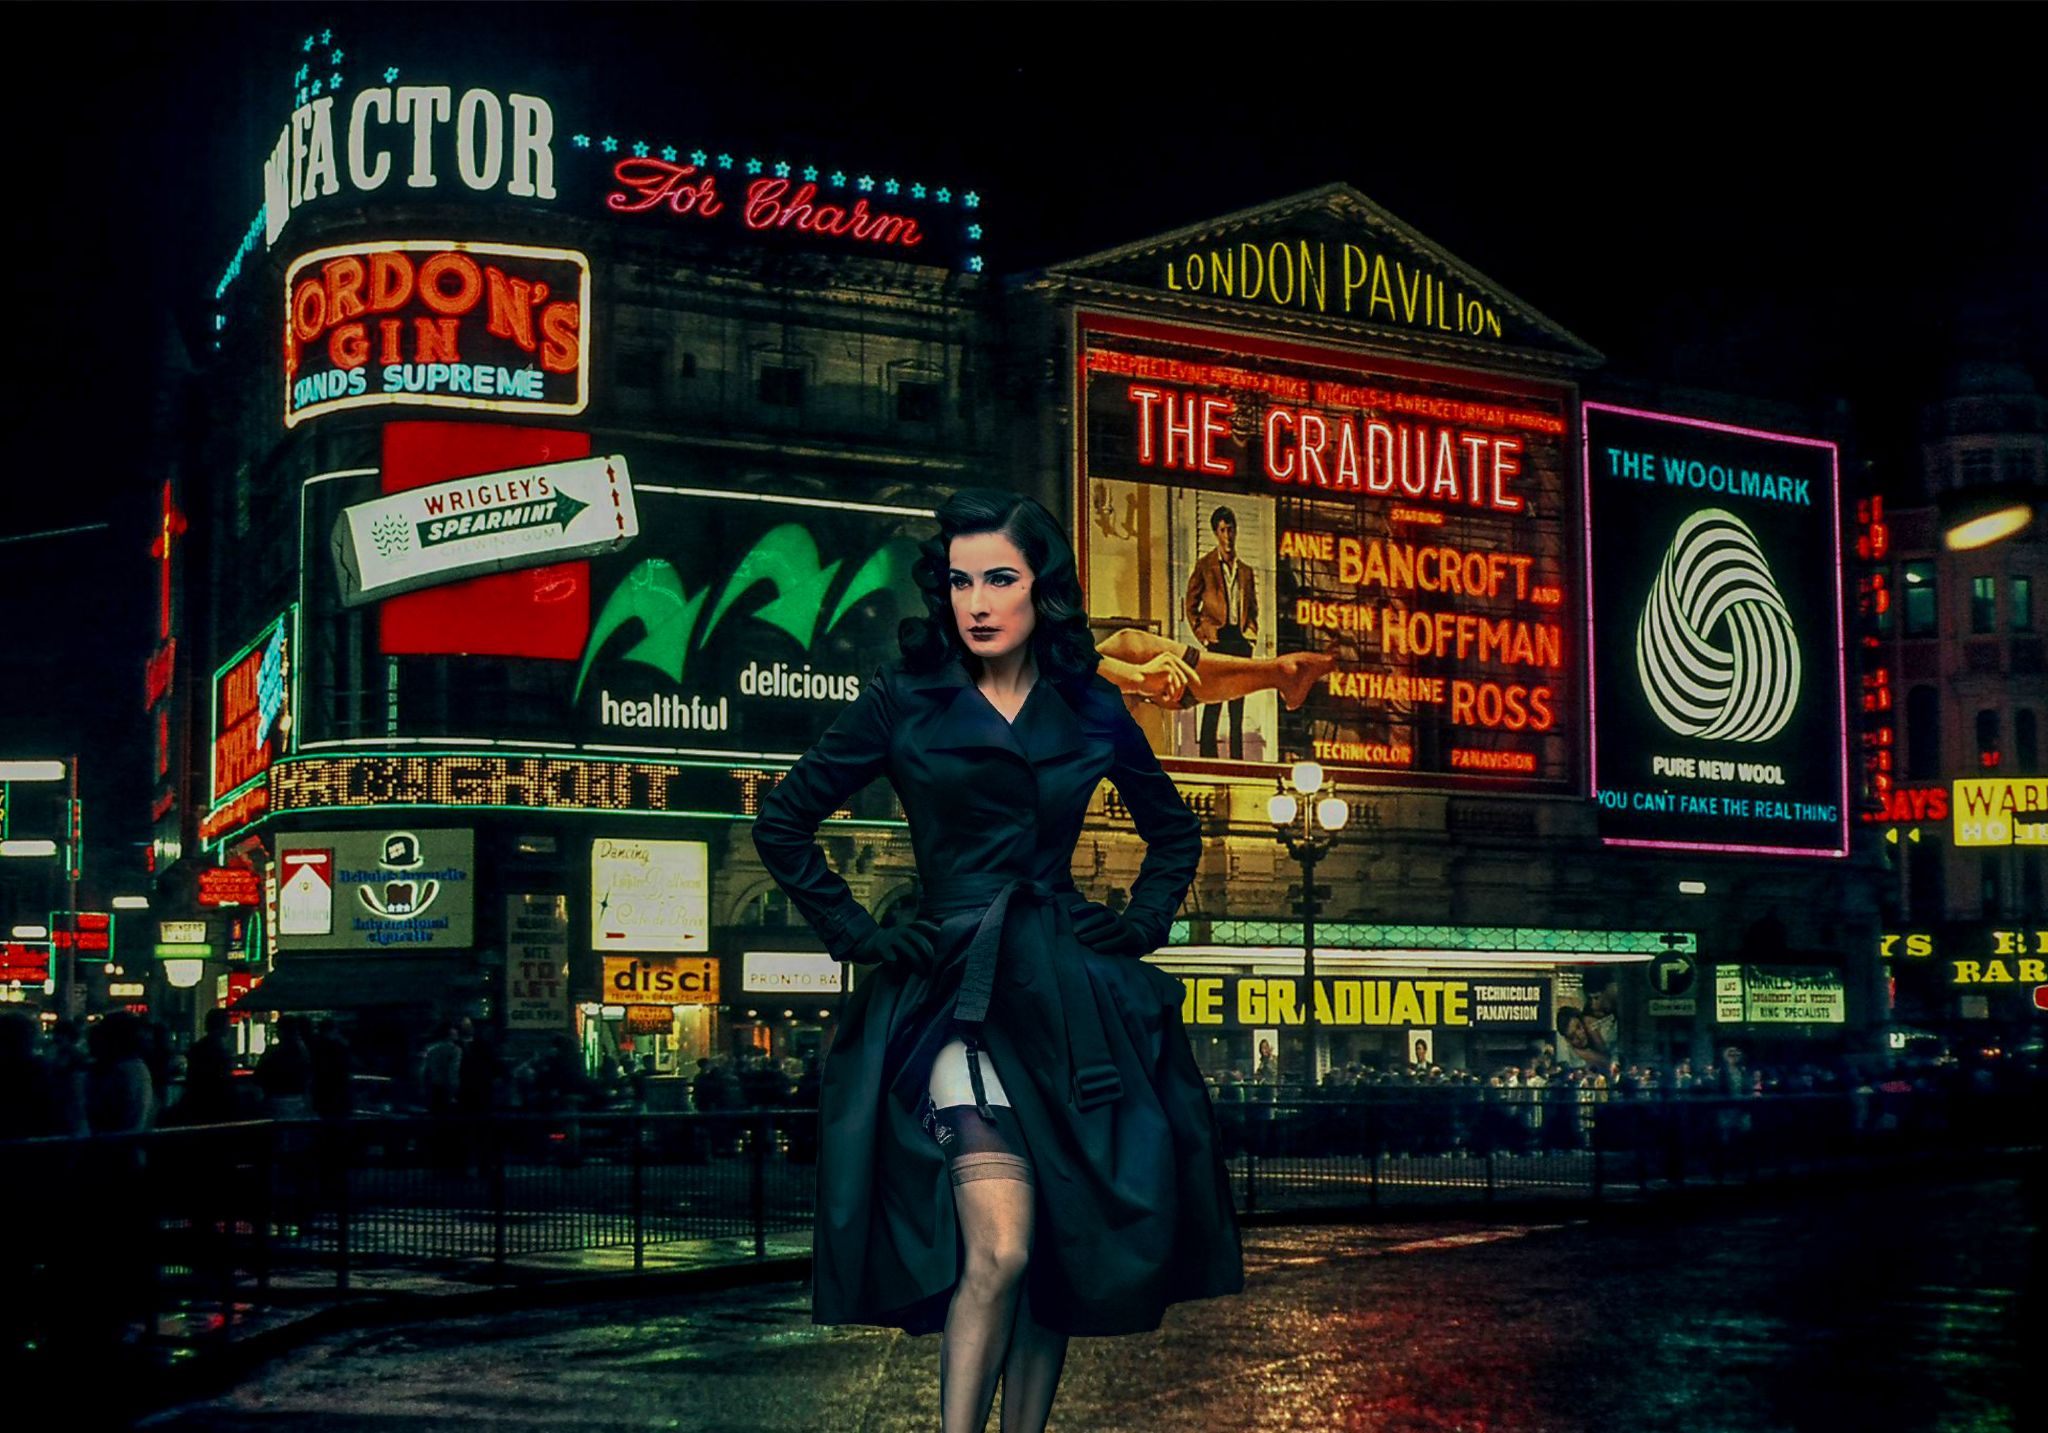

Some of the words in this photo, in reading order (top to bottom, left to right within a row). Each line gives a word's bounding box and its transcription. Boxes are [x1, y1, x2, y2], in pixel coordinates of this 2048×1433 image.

[290, 86, 556, 209] FACTOR
[607, 157, 724, 217] For
[744, 178, 923, 246] Charm
[1167, 241, 1326, 311] LONDON
[1343, 244, 1502, 337] PAVILION
[287, 250, 580, 373] ORDON'S
[328, 317, 460, 370] GIN
[383, 364, 545, 400] SUPREME
[1167, 361, 1209, 383] LEVINE
[1273, 376, 1309, 398] MIKE
[1451, 402, 1504, 425] TURMAN
[1130, 386, 1234, 475] THE
[1265, 407, 1525, 510] GRADUATE
[424, 475, 549, 516] WRIGLEY'S
[1608, 448, 1655, 481] THE
[1662, 457, 1811, 506] WOOLMARK
[428, 501, 559, 541] SPEARMINT
[1280, 531, 1334, 561] ANNE
[1338, 538, 1535, 601] BANCROFT
[1531, 586, 1561, 605] AND
[1297, 600, 1374, 632] DUSTIN
[1381, 606, 1562, 669] HOFFMAN
[740, 661, 859, 701] delicious
[1329, 671, 1445, 703] KATHARINE
[1451, 679, 1554, 730] ROSS
[601, 690, 728, 731] healthful
[1313, 741, 1412, 763] TECHNICOLOR
[1451, 748, 1535, 770] PANAVISION
[1653, 756, 1696, 778] PURE
[1699, 759, 1735, 781] NEW
[1738, 763, 1785, 785] WOOL
[1597, 790, 1627, 809] YOU
[1633, 789, 1675, 811] CAN'T
[1681, 796, 1718, 815] FAKE
[1722, 798, 1749, 817] THE
[1755, 801, 1791, 820] REAL
[1793, 803, 1837, 822] THING
[1963, 785, 2048, 817] WAR
[614, 960, 711, 992] disci
[751, 973, 811, 985] PRONTO
[1474, 986, 1540, 1001] TECHNICOLOR
[1238, 978, 1468, 1025] GRADUATE
[1476, 1005, 1537, 1020] PANAVISION
[1760, 1007, 1779, 1018] RING
[1784, 1007, 1830, 1018] SPECIALISTS
